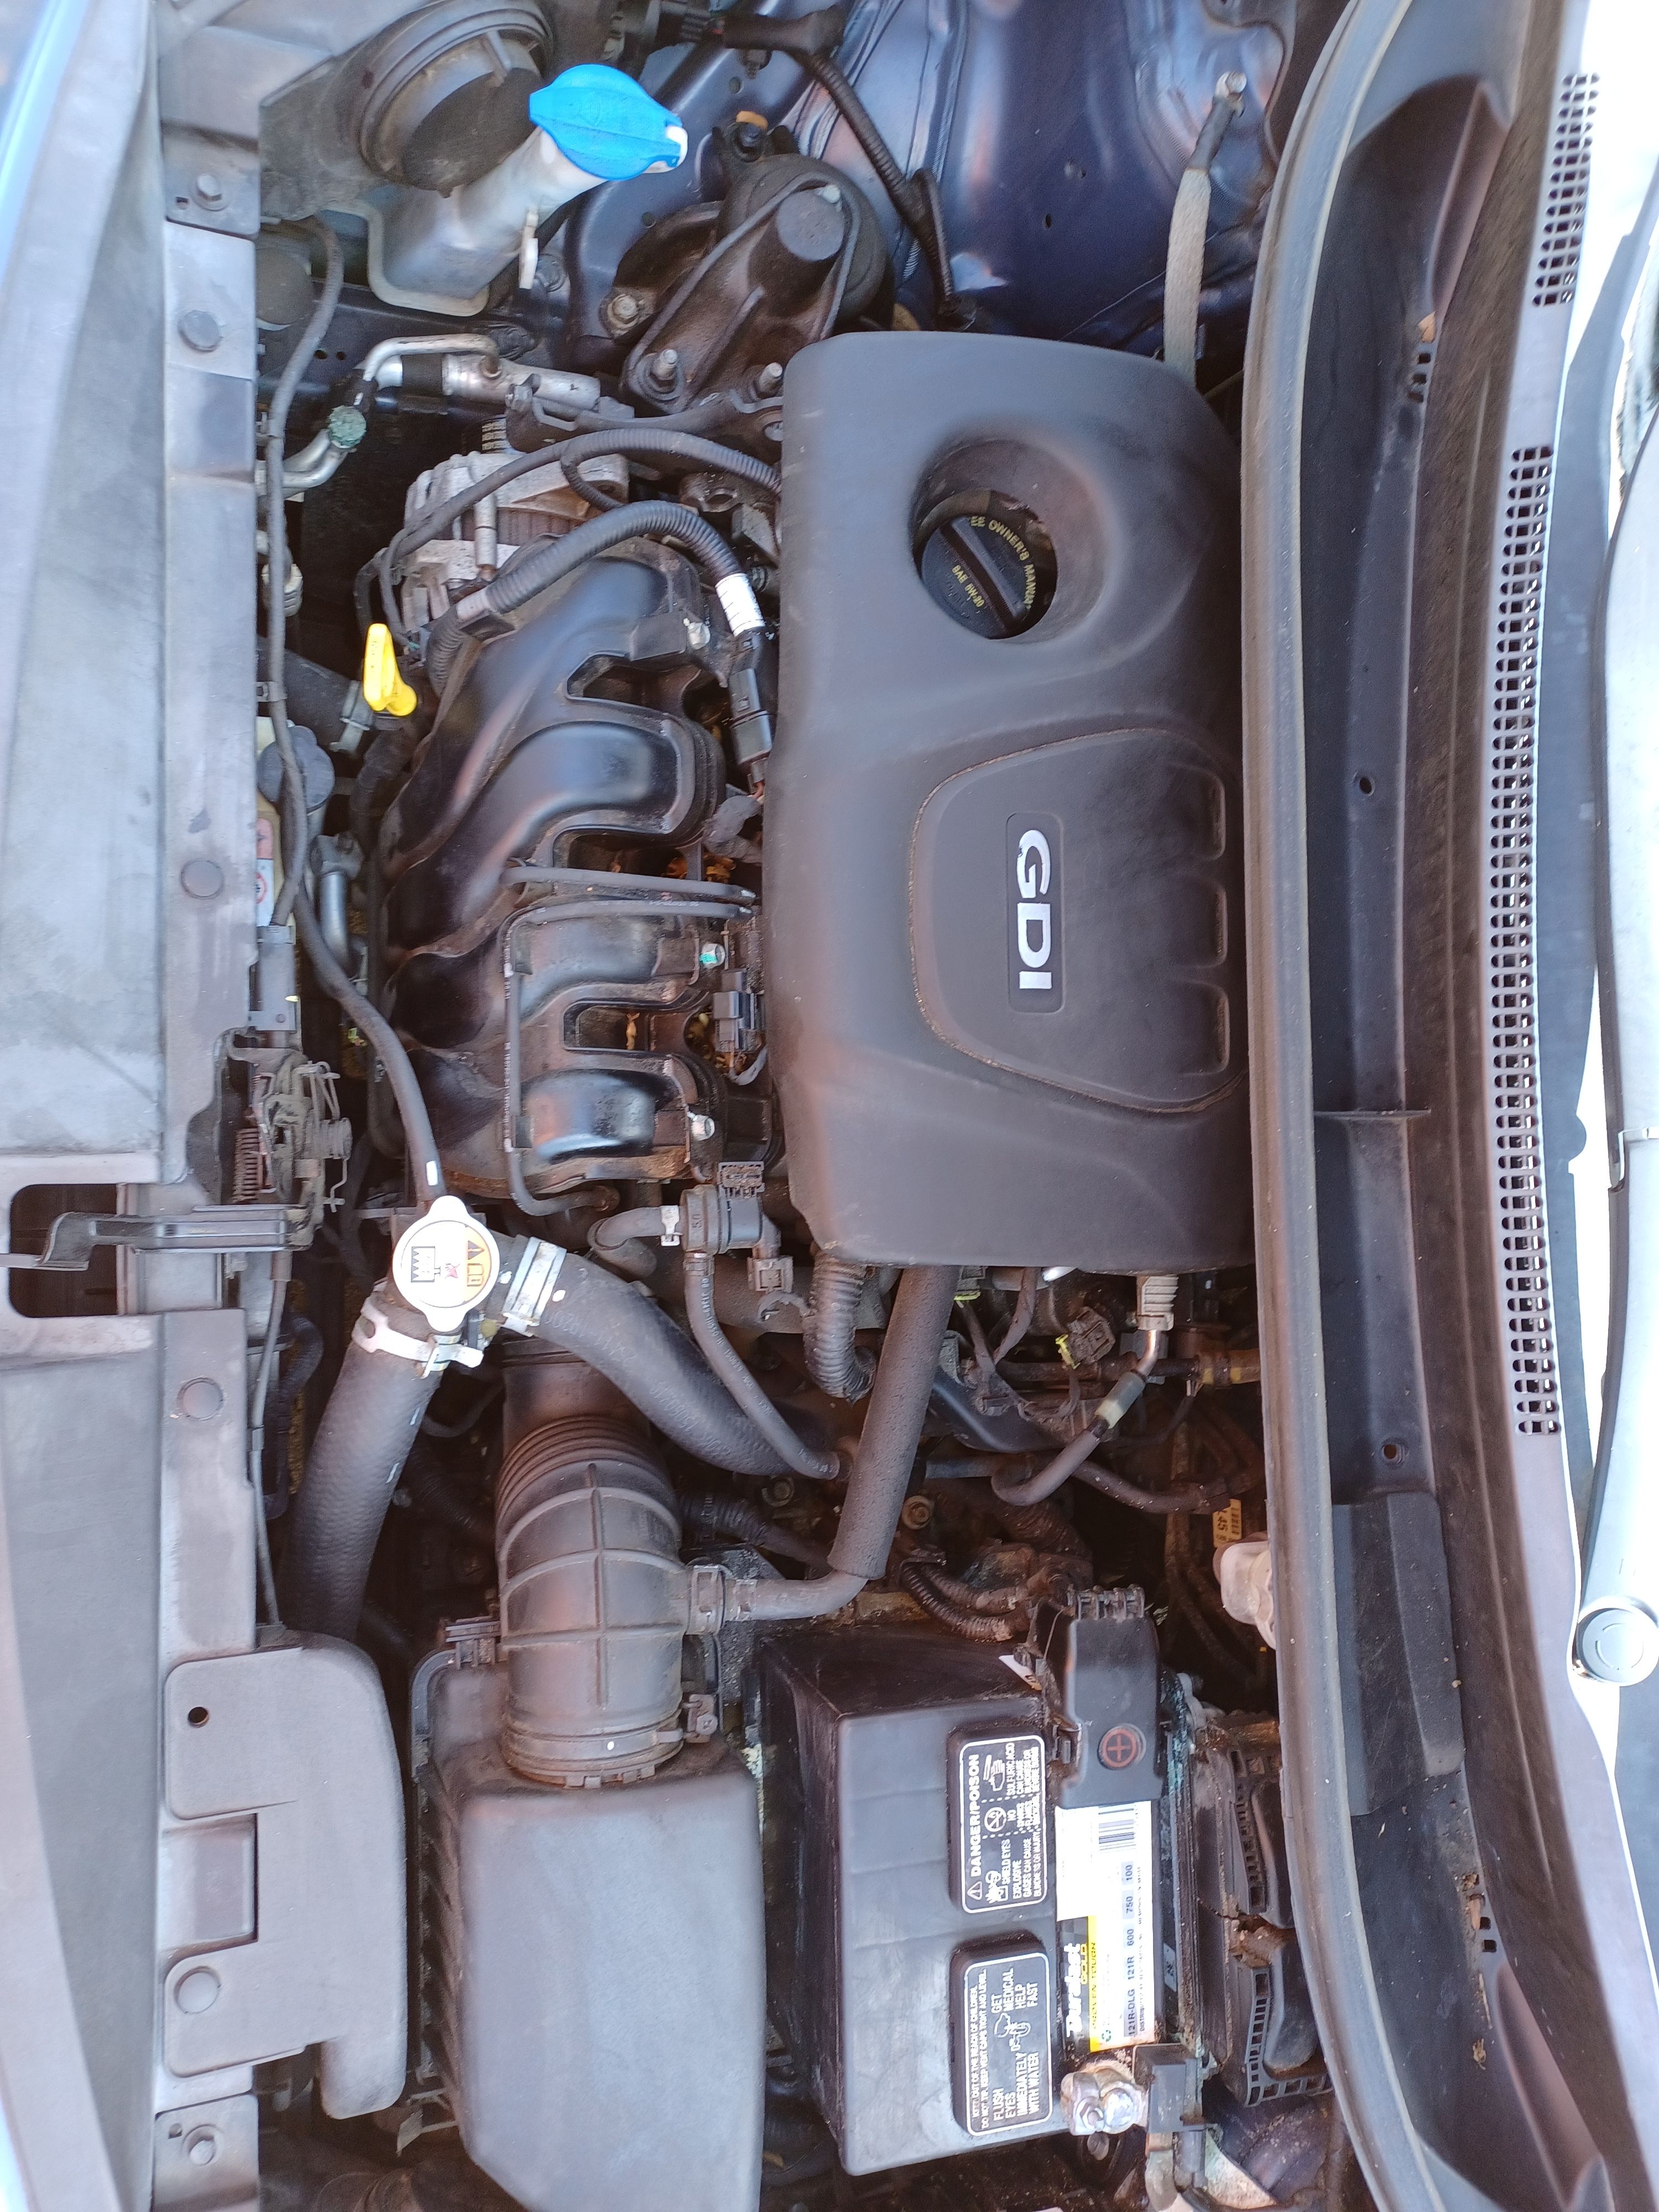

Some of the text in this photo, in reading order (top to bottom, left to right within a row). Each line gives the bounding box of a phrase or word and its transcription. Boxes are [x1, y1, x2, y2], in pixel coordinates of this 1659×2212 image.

[969, 516, 985, 527] EE
[989, 520, 1029, 561] OWNER'S
[952, 565, 984, 607] SAE 5W-20
[1017, 830, 1052, 989] GDI
[1006, 1743, 1015, 1796] SULFURIC ACID
[969, 1755, 981, 1876] DANGER/POISON
[1008, 1810, 1016, 1820] NO
[1001, 1839, 1010, 1884] SHIELD EYES
[1033, 1854, 1041, 1863] OR
[1013, 1860, 1021, 1898] EXPLOSIVE
[1024, 1874, 1032, 1897] GASES
[992, 1994, 1003, 2013] GET
[1003, 1968, 1014, 2011] MEDICAL
[1015, 1984, 1026, 2009] HELP
[1027, 1983, 1037, 2007] FAST
[1064, 1943, 1082, 2037] Duralast
[971, 2023, 978, 2031] OF
[971, 2073, 979, 2082] OF
[1016, 2052, 1028, 2116] IMMEDIATELY
[1028, 2052, 1039, 2114] WITH WATER
[993, 2088, 1004, 2120] FLUSH
[1005, 2093, 1016, 2118] EYES
[982, 2117, 989, 2128] DO
